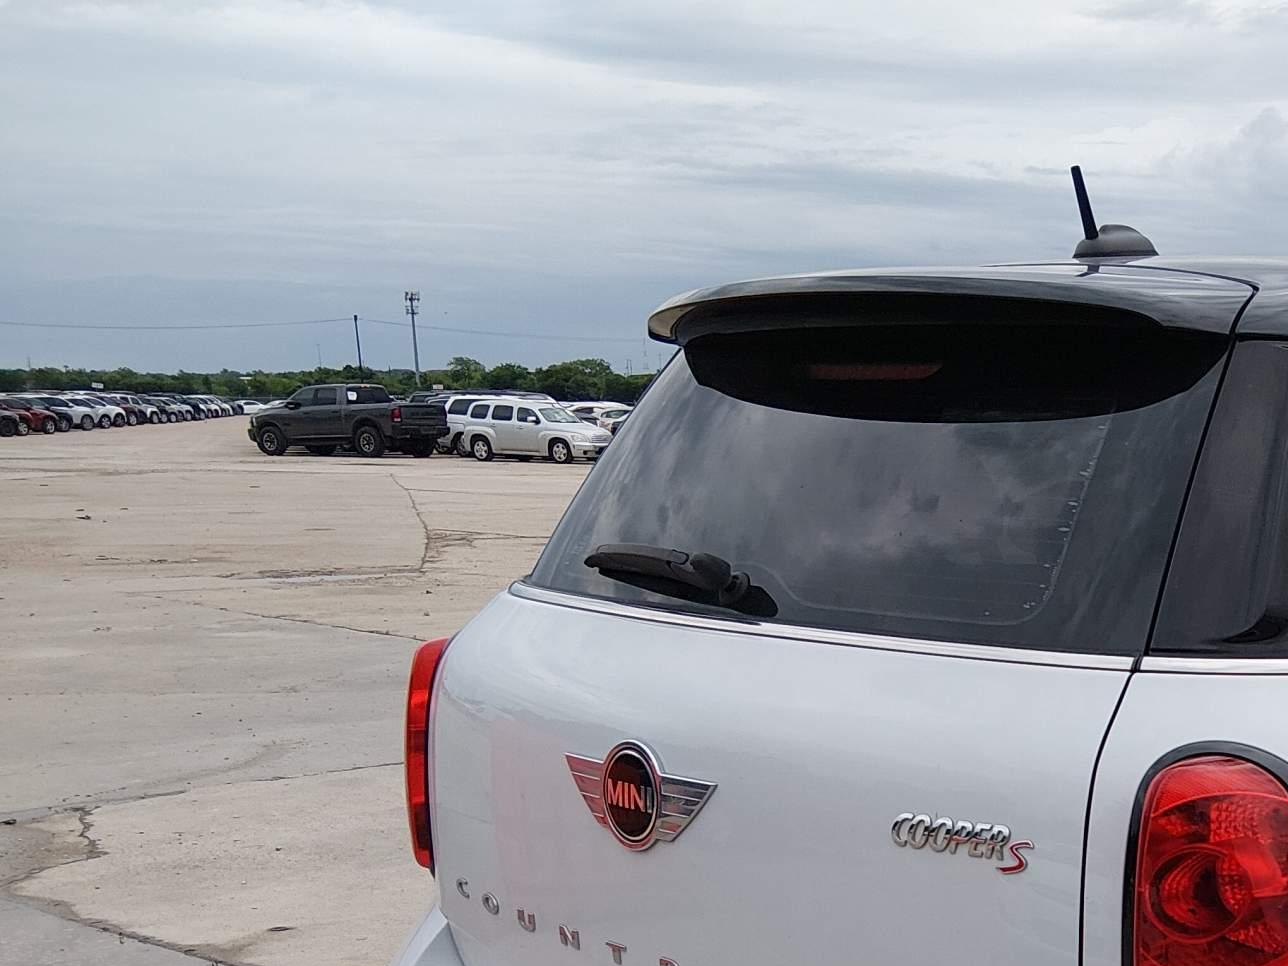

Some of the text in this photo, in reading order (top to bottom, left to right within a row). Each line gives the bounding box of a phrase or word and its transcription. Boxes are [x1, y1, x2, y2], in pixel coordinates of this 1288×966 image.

[607, 778, 653, 813] MINI
[891, 812, 1034, 874] COOPER S
